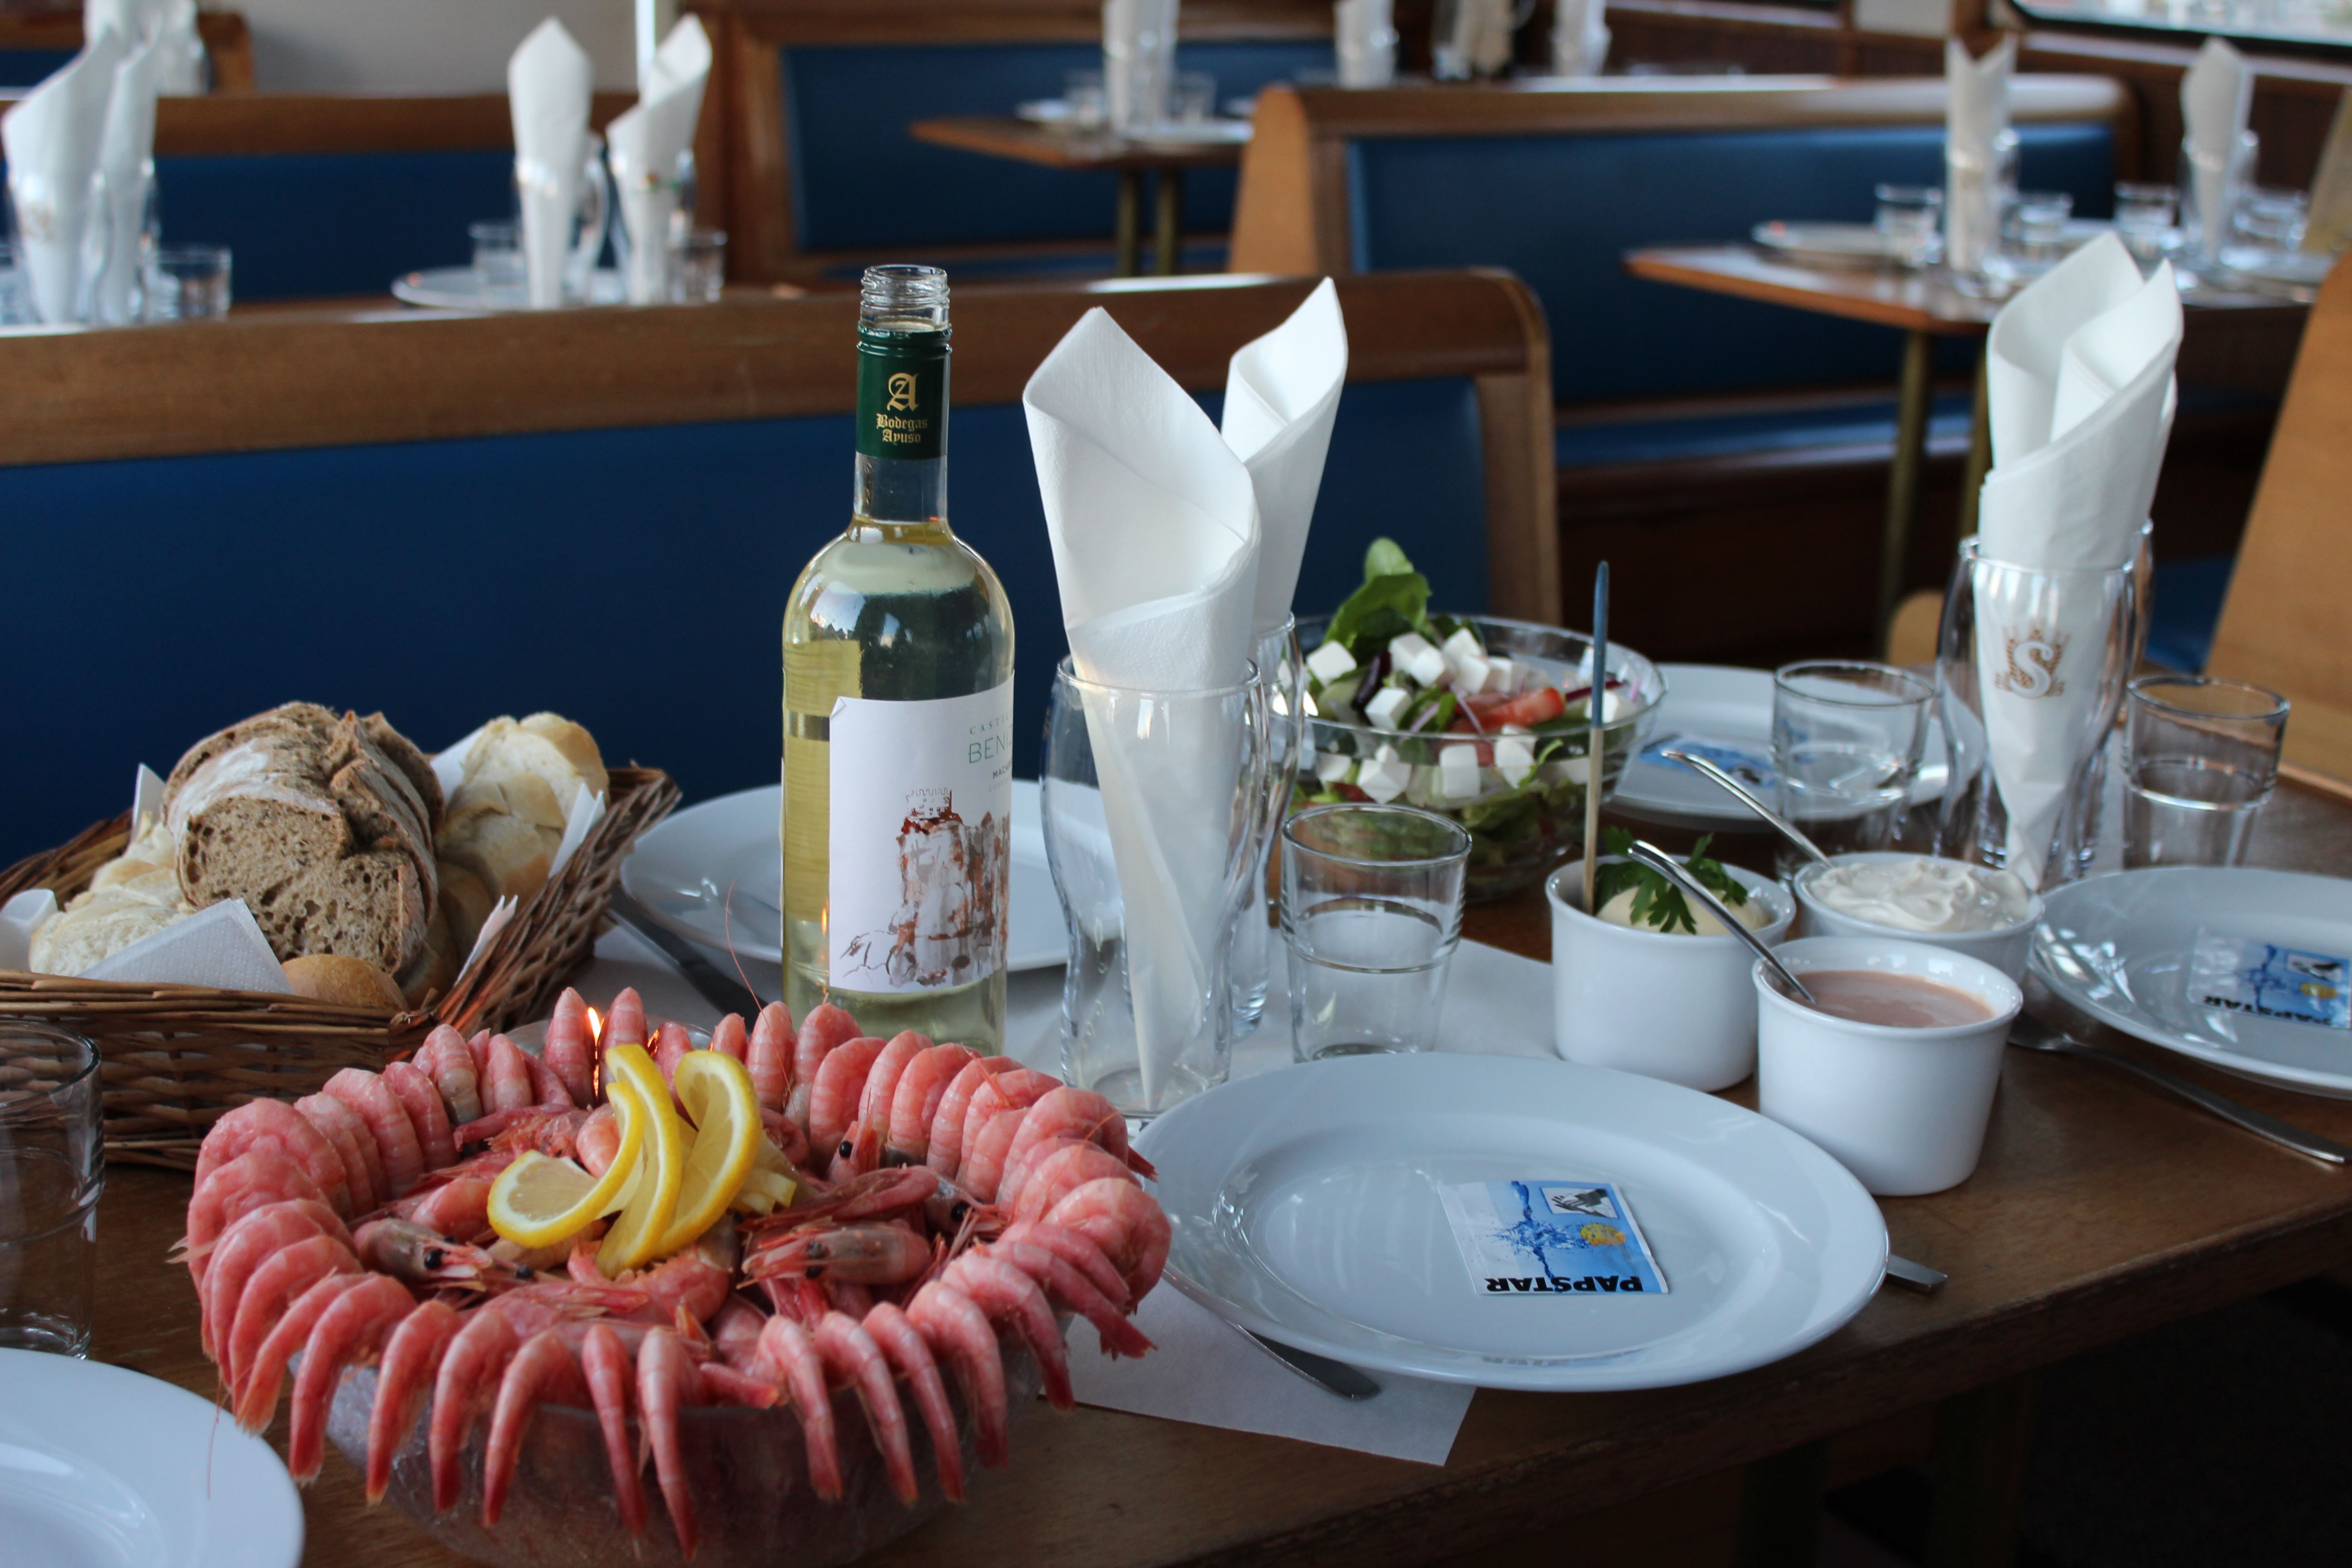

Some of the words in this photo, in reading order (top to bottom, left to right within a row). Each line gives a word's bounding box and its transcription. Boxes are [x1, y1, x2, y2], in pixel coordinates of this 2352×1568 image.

[887, 372, 919, 411] A
[876, 413, 928, 431] Bodegas
[882, 429, 921, 445] Ayuso
[1484, 1275, 1644, 1293] PAPSTAR
